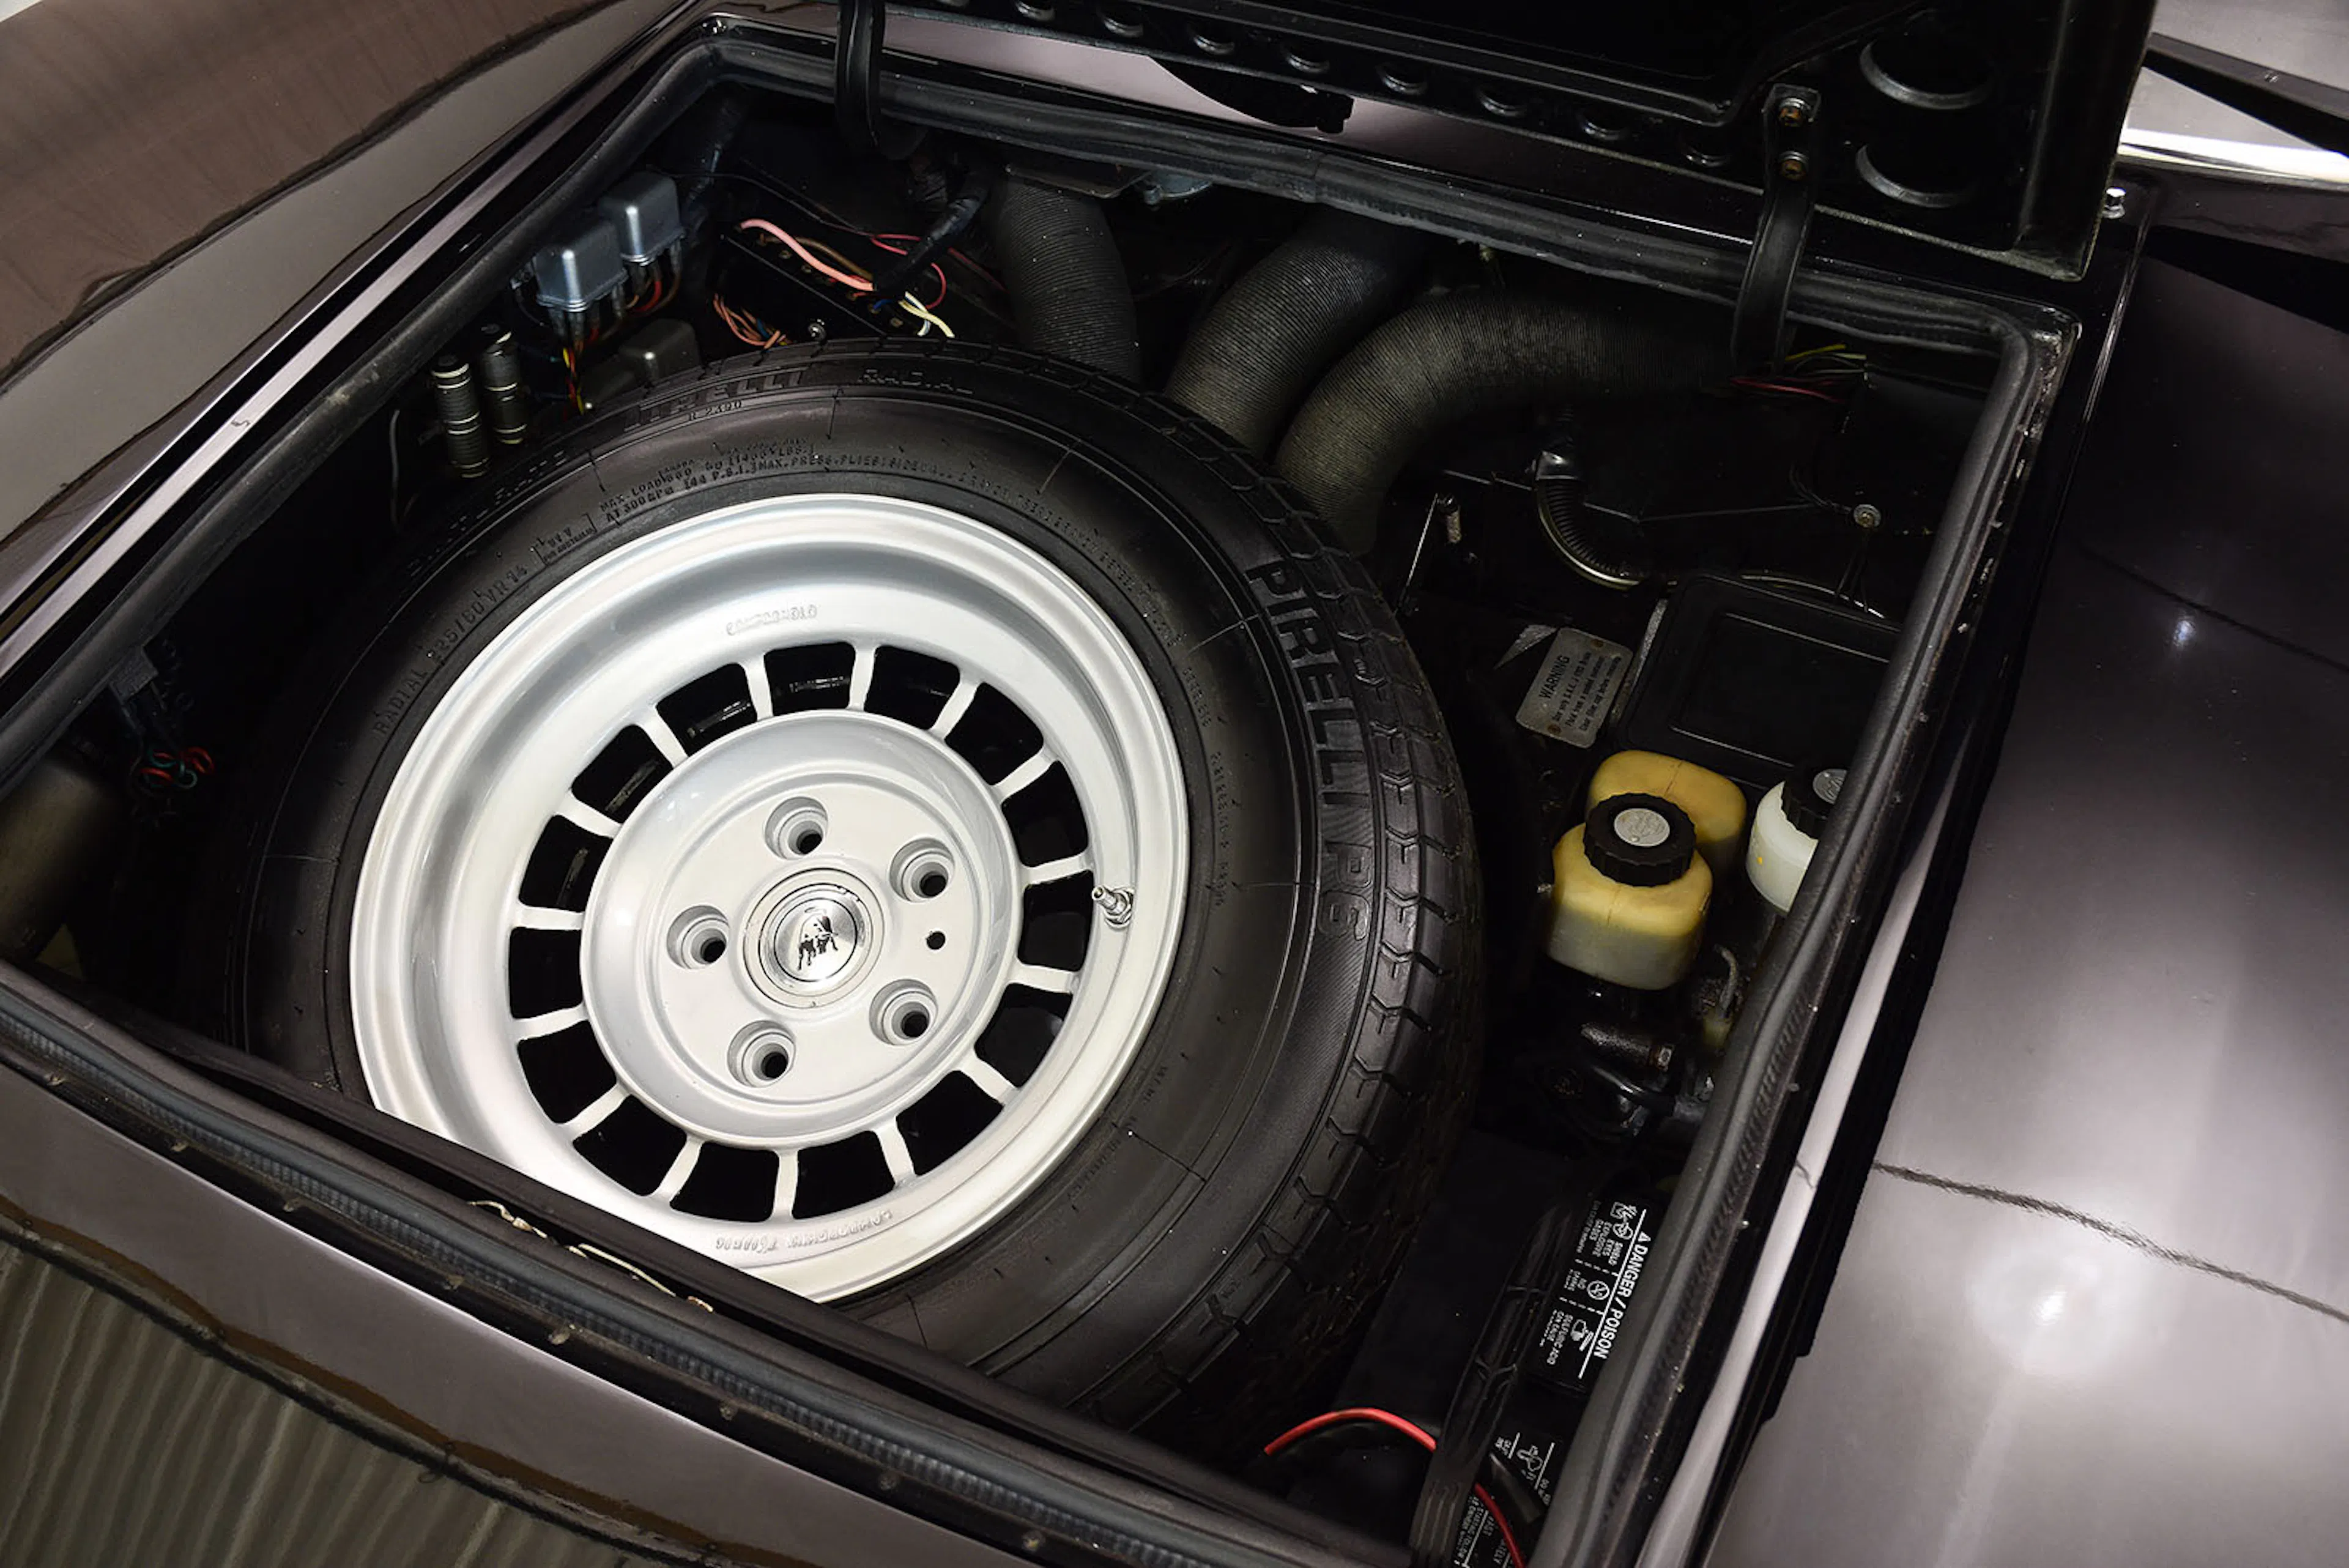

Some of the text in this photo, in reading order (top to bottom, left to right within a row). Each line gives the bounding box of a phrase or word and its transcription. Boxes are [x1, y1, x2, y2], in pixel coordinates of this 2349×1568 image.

[1248, 559, 1370, 806] PIRELLI
[1538, 655, 1570, 699] WARNING
[1593, 1244, 1648, 1359] DANGER / POISON
